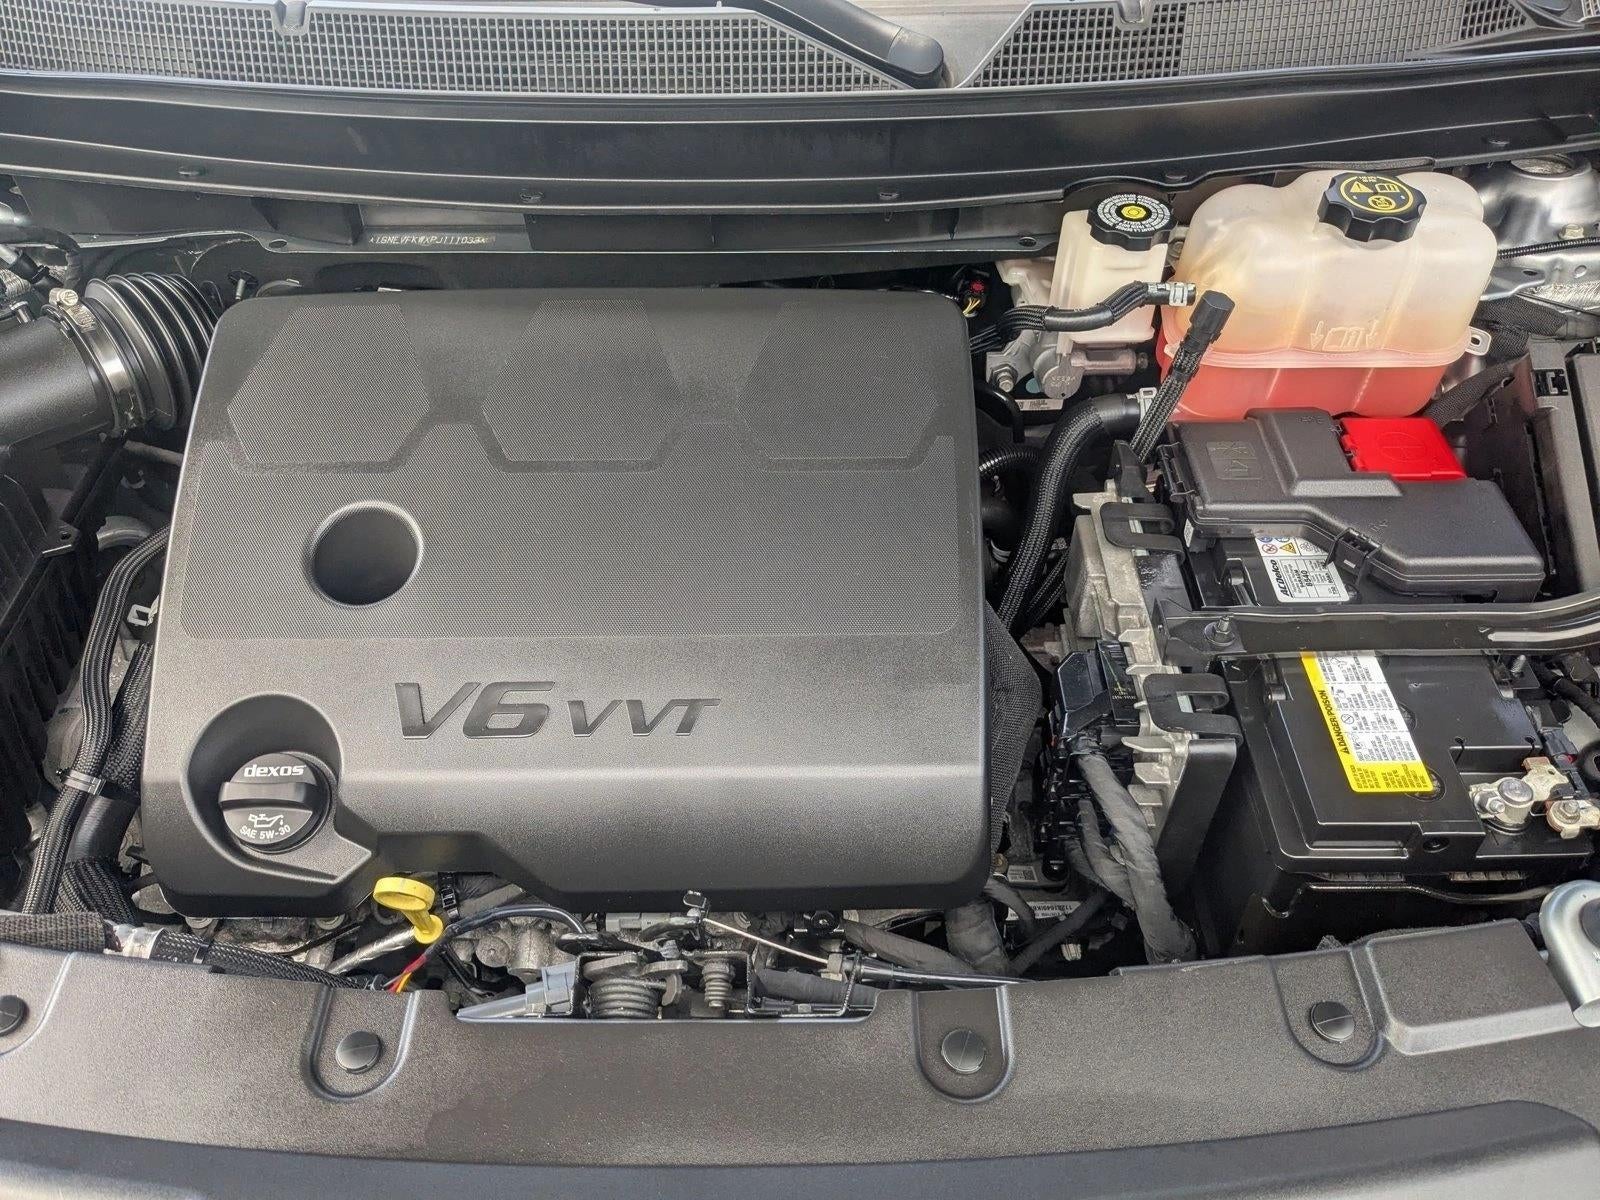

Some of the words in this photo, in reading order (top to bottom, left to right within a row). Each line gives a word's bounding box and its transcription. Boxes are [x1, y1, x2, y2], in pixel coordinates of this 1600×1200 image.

[1270, 559, 1290, 596] ACDelco
[395, 681, 555, 739] V6
[567, 698, 721, 737] VVT
[243, 764, 306, 778] dexos
[240, 825, 256, 839] SAE
[260, 824, 291, 839] 5W-30
